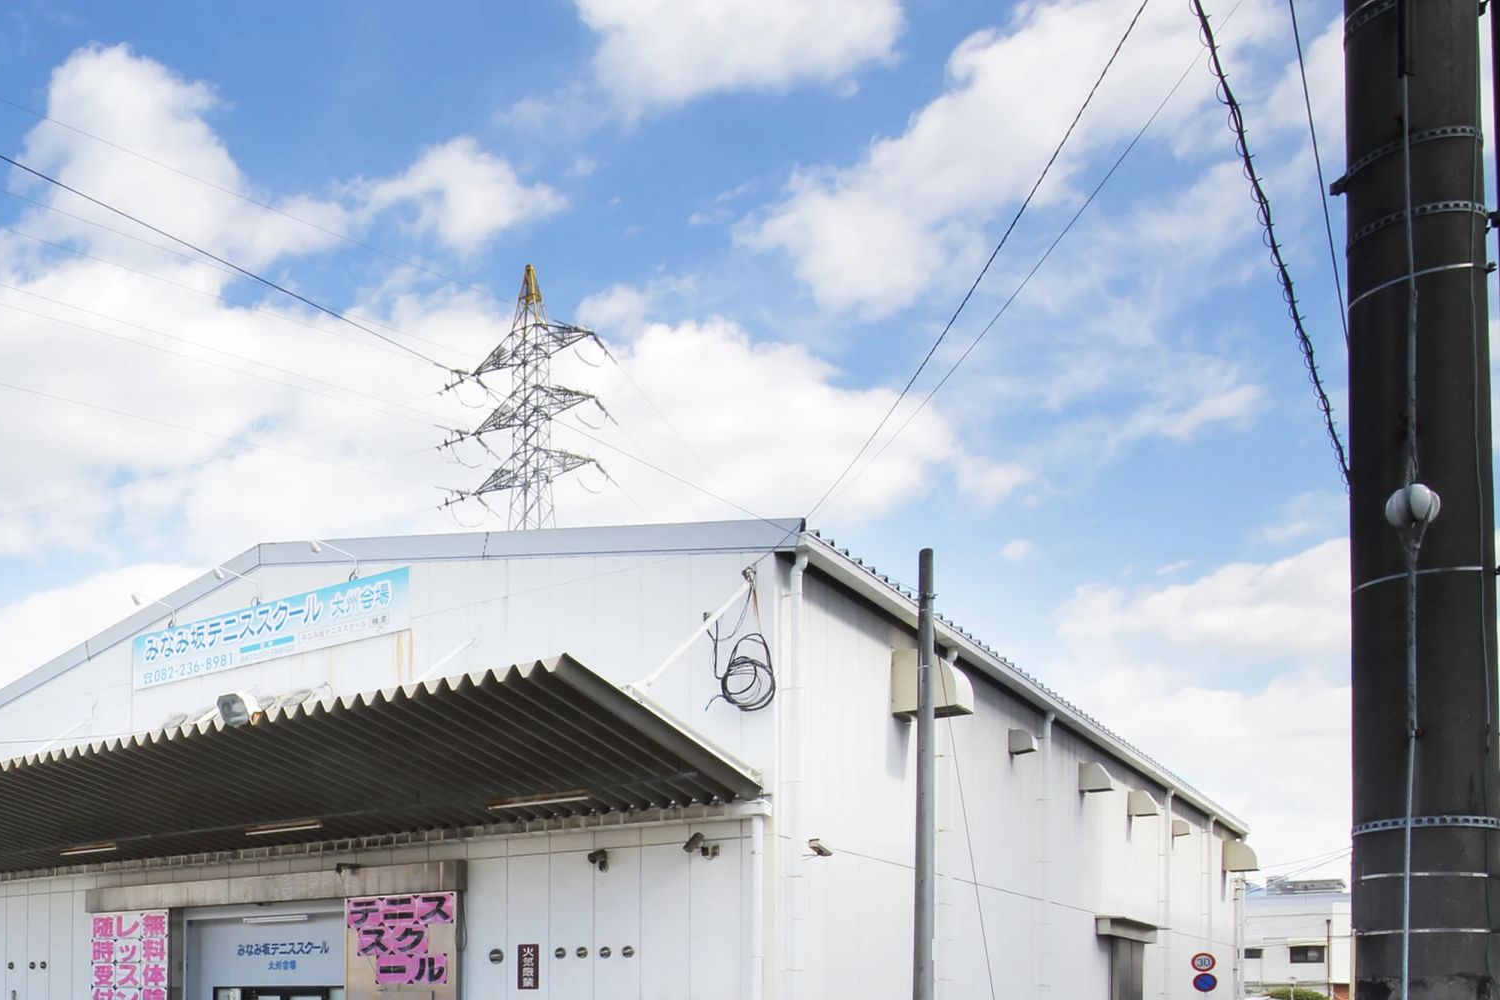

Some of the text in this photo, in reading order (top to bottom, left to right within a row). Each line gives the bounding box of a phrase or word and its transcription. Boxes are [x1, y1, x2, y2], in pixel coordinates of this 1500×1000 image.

[145, 593, 322, 662] みなみ坂テニススクール
[154, 652, 235, 683] 082-236-8981
[350, 896, 450, 924] テニス
[237, 941, 329, 956] みなみ坂テニススクール
[361, 928, 425, 953] スク
[1196, 958, 1210, 967] 30
